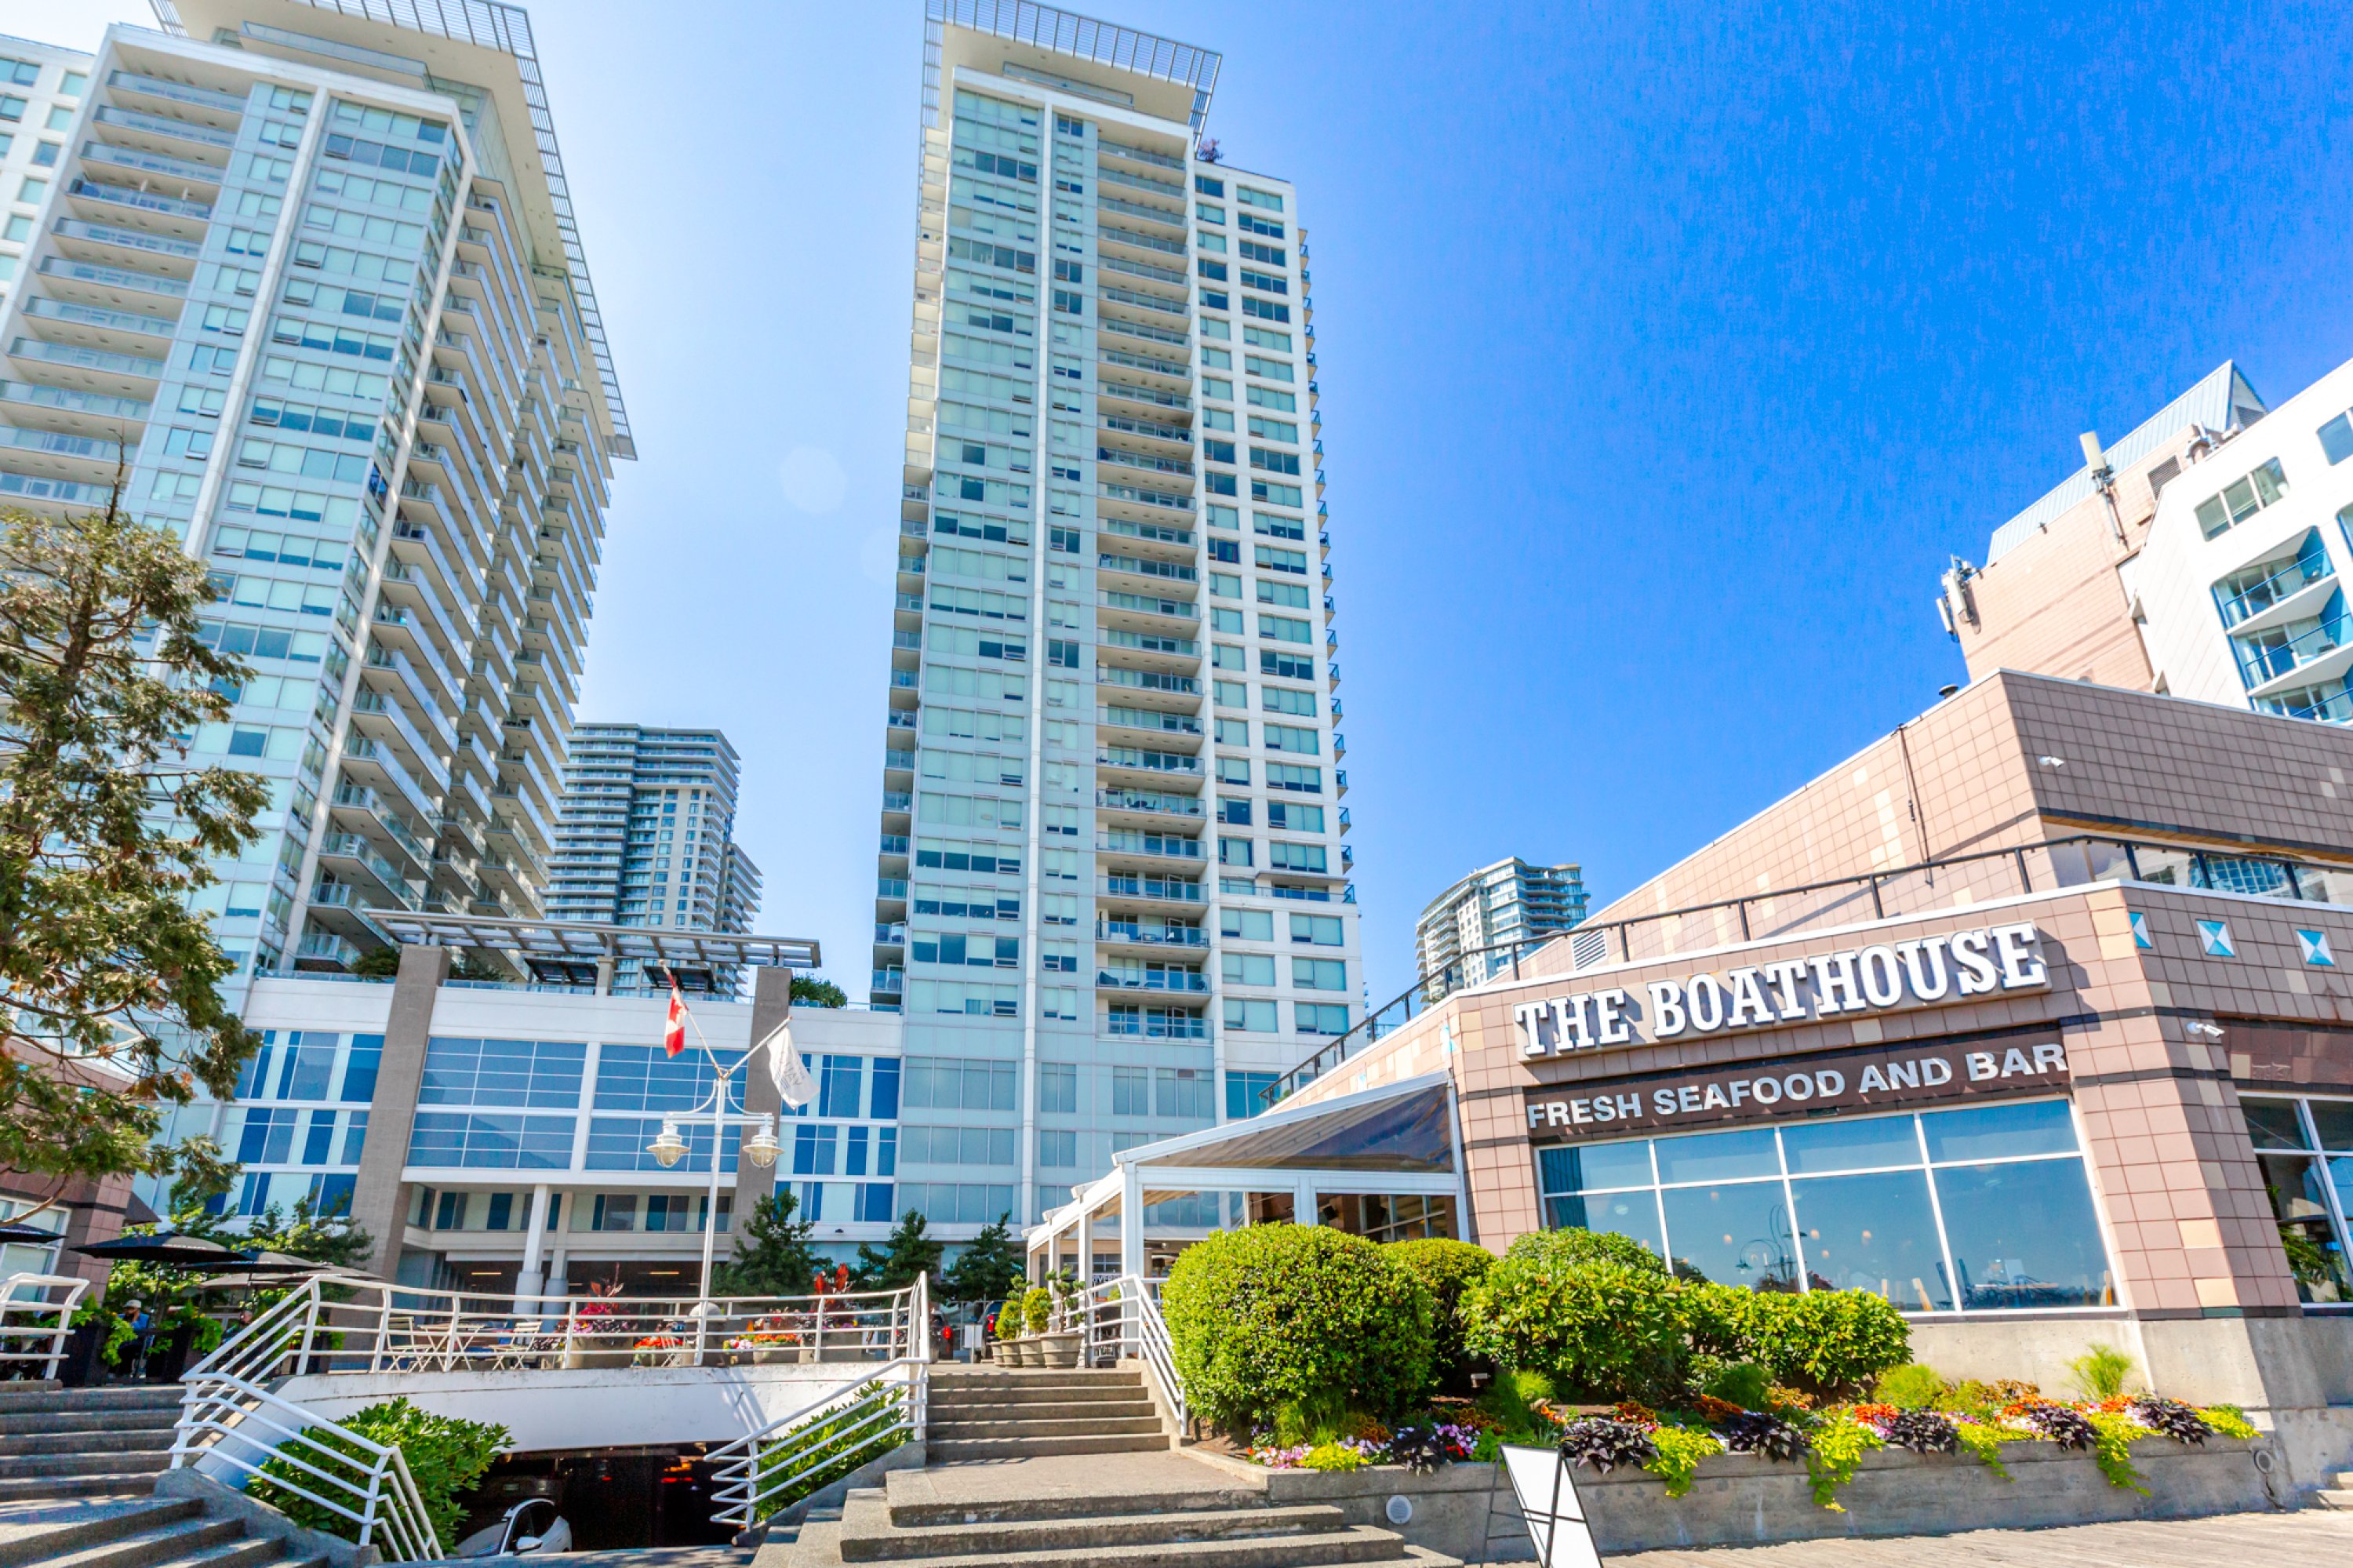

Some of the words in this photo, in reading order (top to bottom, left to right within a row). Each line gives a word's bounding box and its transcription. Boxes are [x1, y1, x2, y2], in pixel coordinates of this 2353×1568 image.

[1515, 988, 1630, 1056] THE
[1648, 921, 2046, 1038] BOATHOUSE
[1526, 1093, 1643, 1129] FRESH
[1653, 1070, 1846, 1115] SEAFOOD
[1858, 1057, 1953, 1094] AND
[1965, 1043, 2069, 1082] BAR
